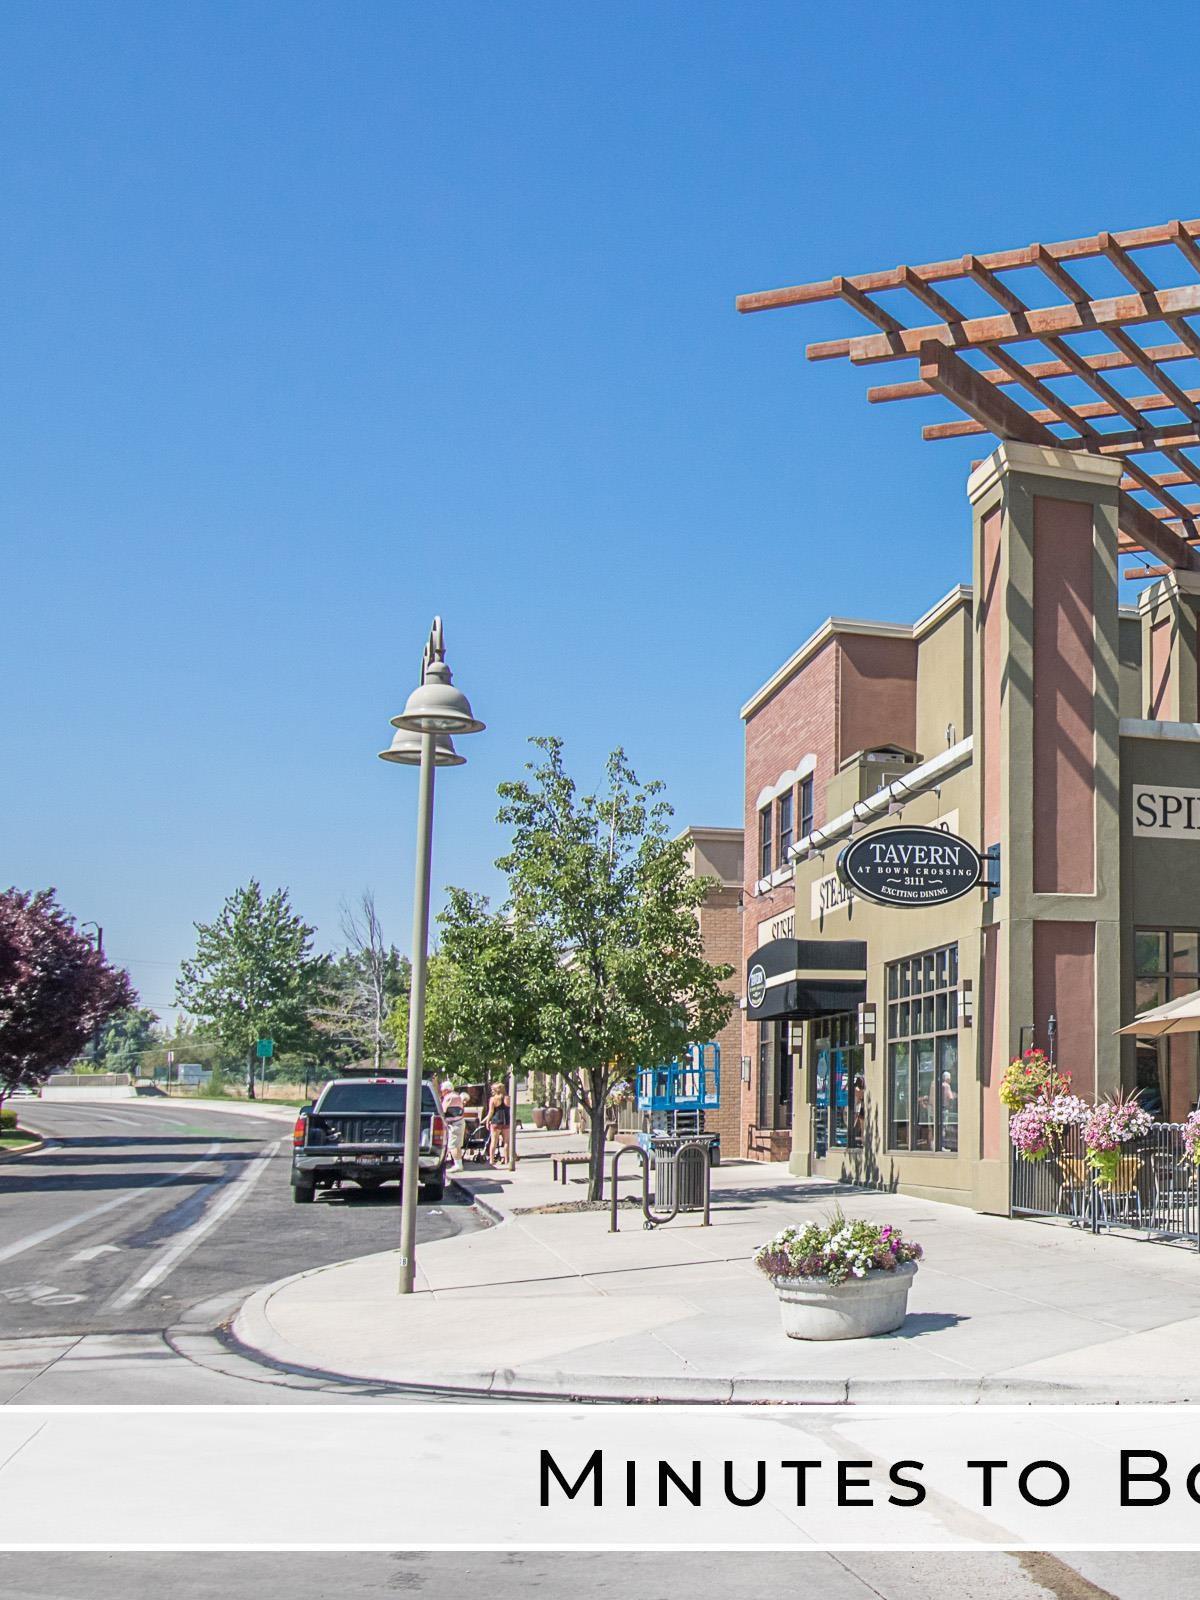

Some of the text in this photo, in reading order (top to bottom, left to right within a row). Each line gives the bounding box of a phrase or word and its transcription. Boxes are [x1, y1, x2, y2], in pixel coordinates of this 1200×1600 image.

[870, 843, 960, 865] TAVERN
[857, 866, 972, 876] AT BOWN CROSSING
[904, 877, 925, 886] 3111
[881, 885, 948, 898] EXCITING DINING
